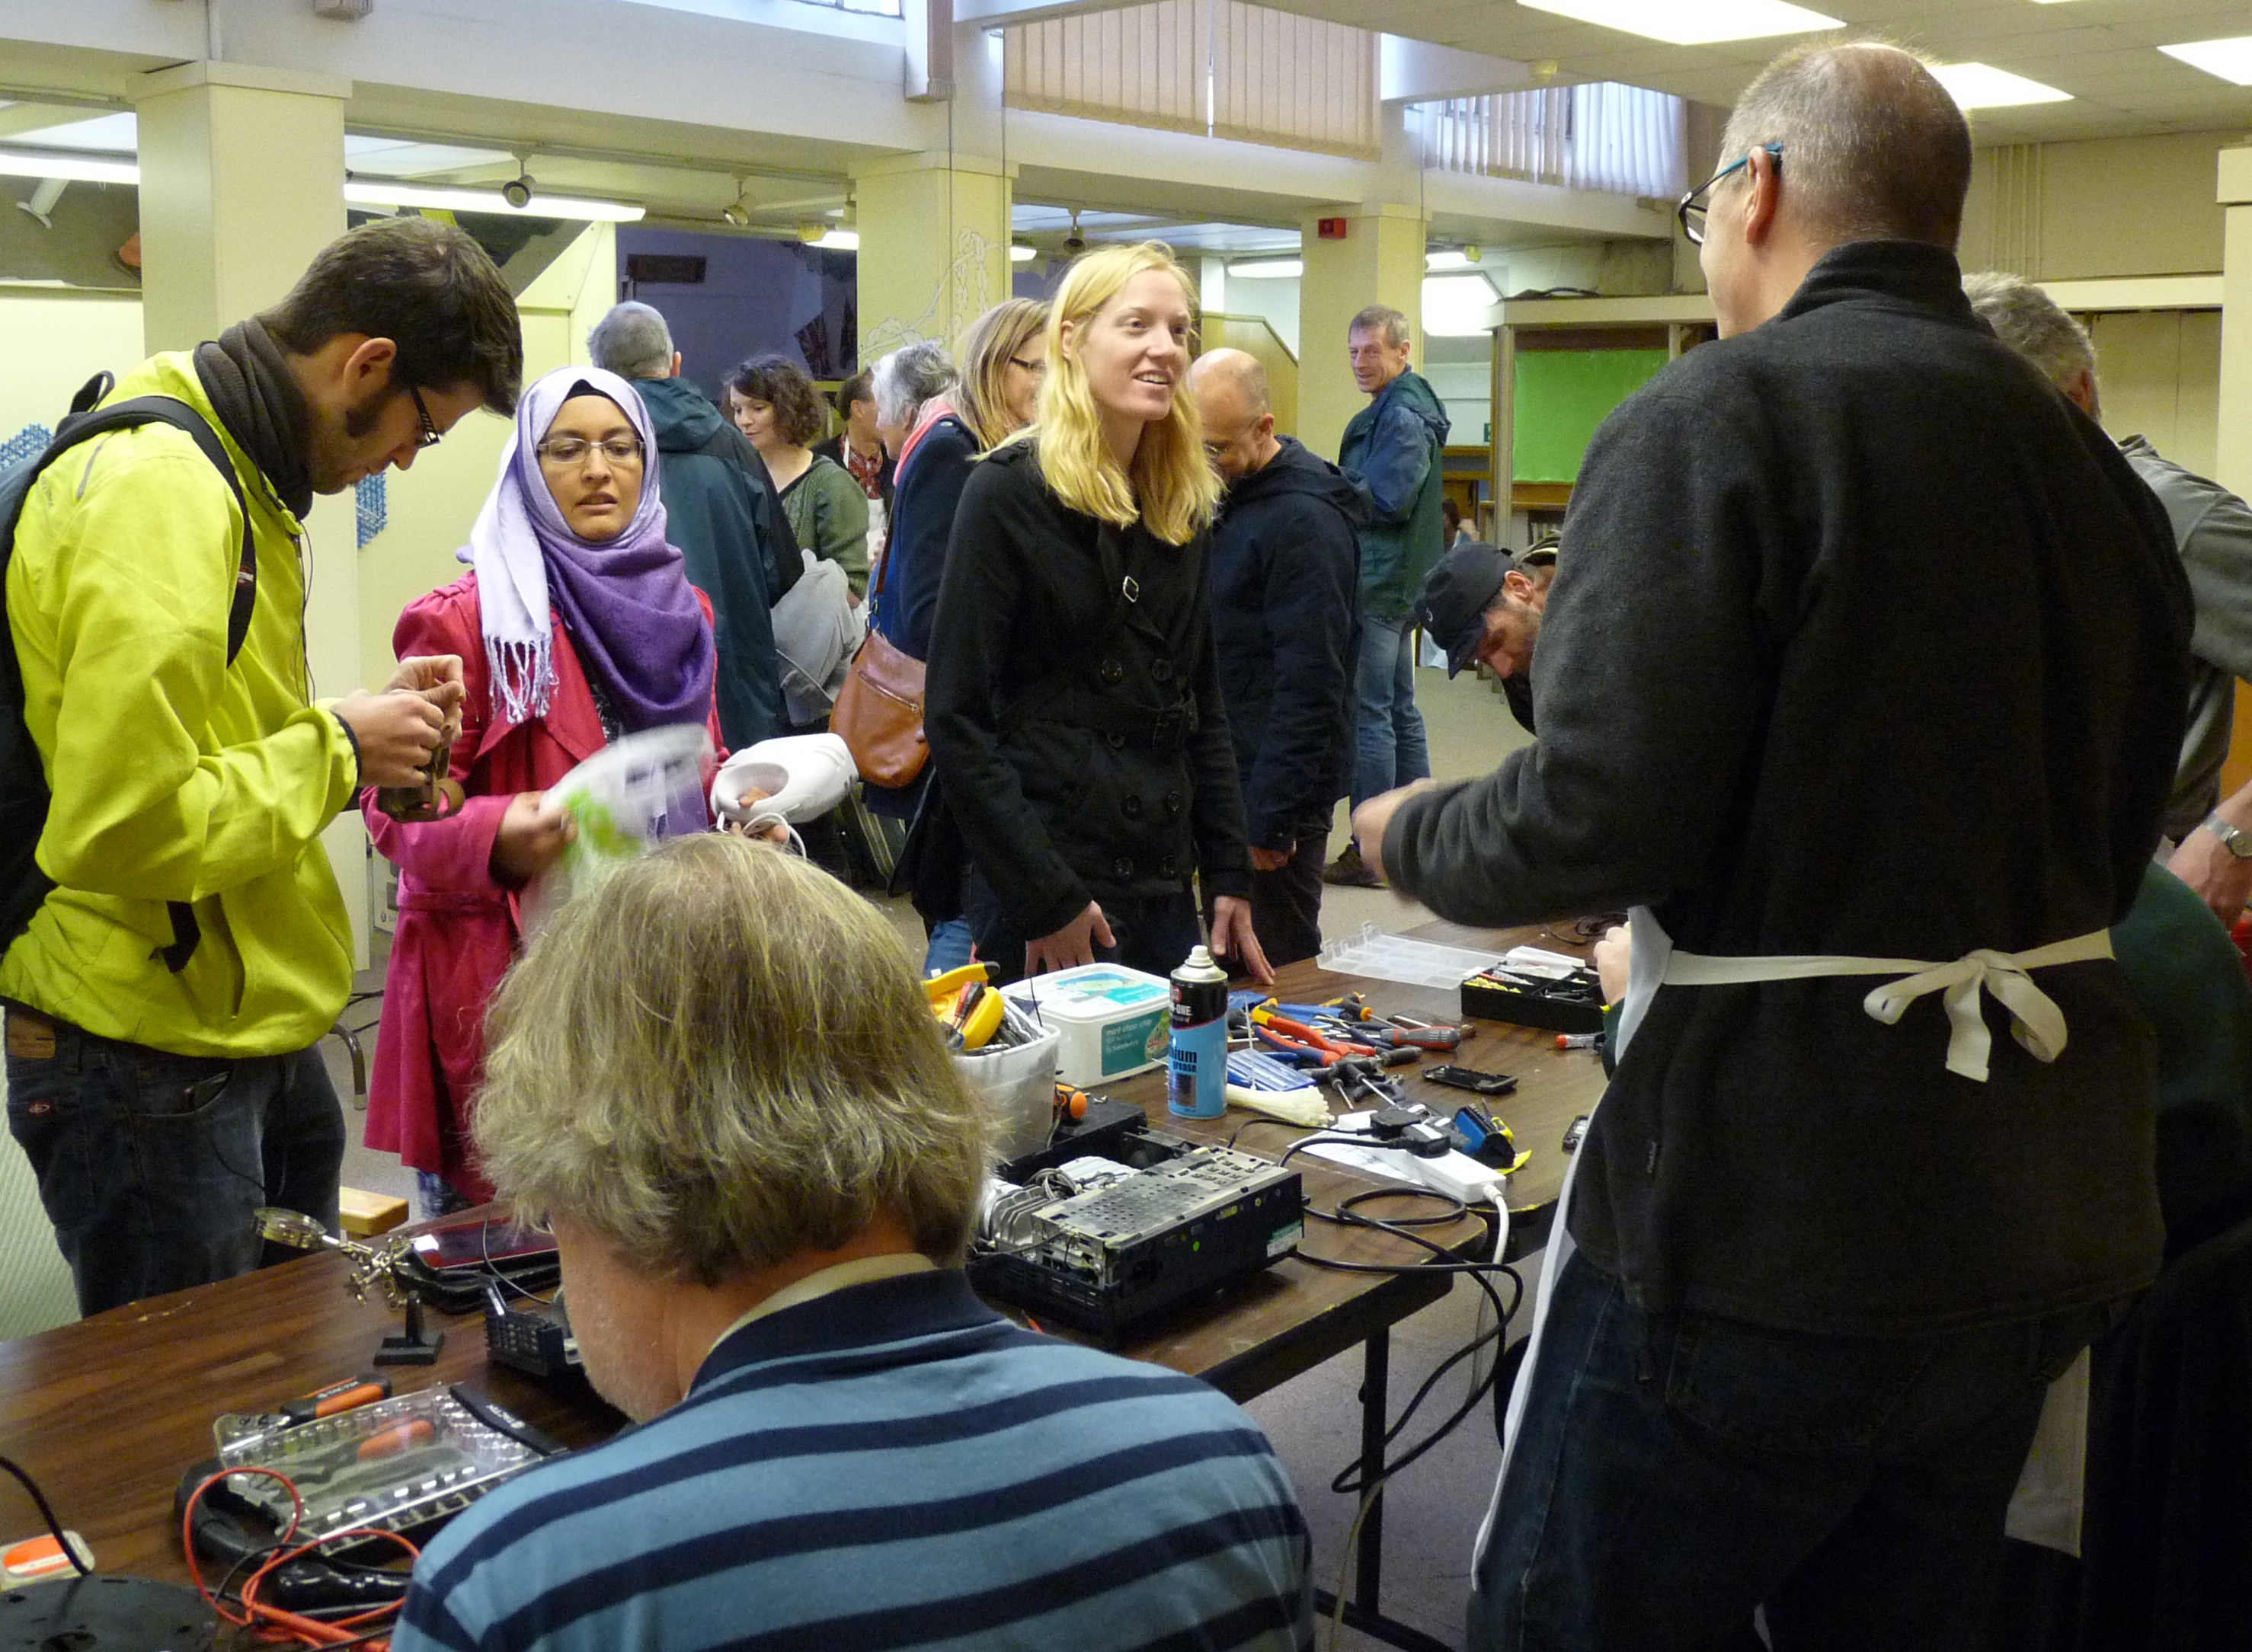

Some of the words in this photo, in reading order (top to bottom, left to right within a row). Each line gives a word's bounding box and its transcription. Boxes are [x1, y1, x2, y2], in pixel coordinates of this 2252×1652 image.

[1106, 1026, 1121, 1036] mint
[1122, 1024, 1138, 1032] choc
[1139, 1019, 1153, 1028] chip
[1172, 1060, 1197, 1072] grease
